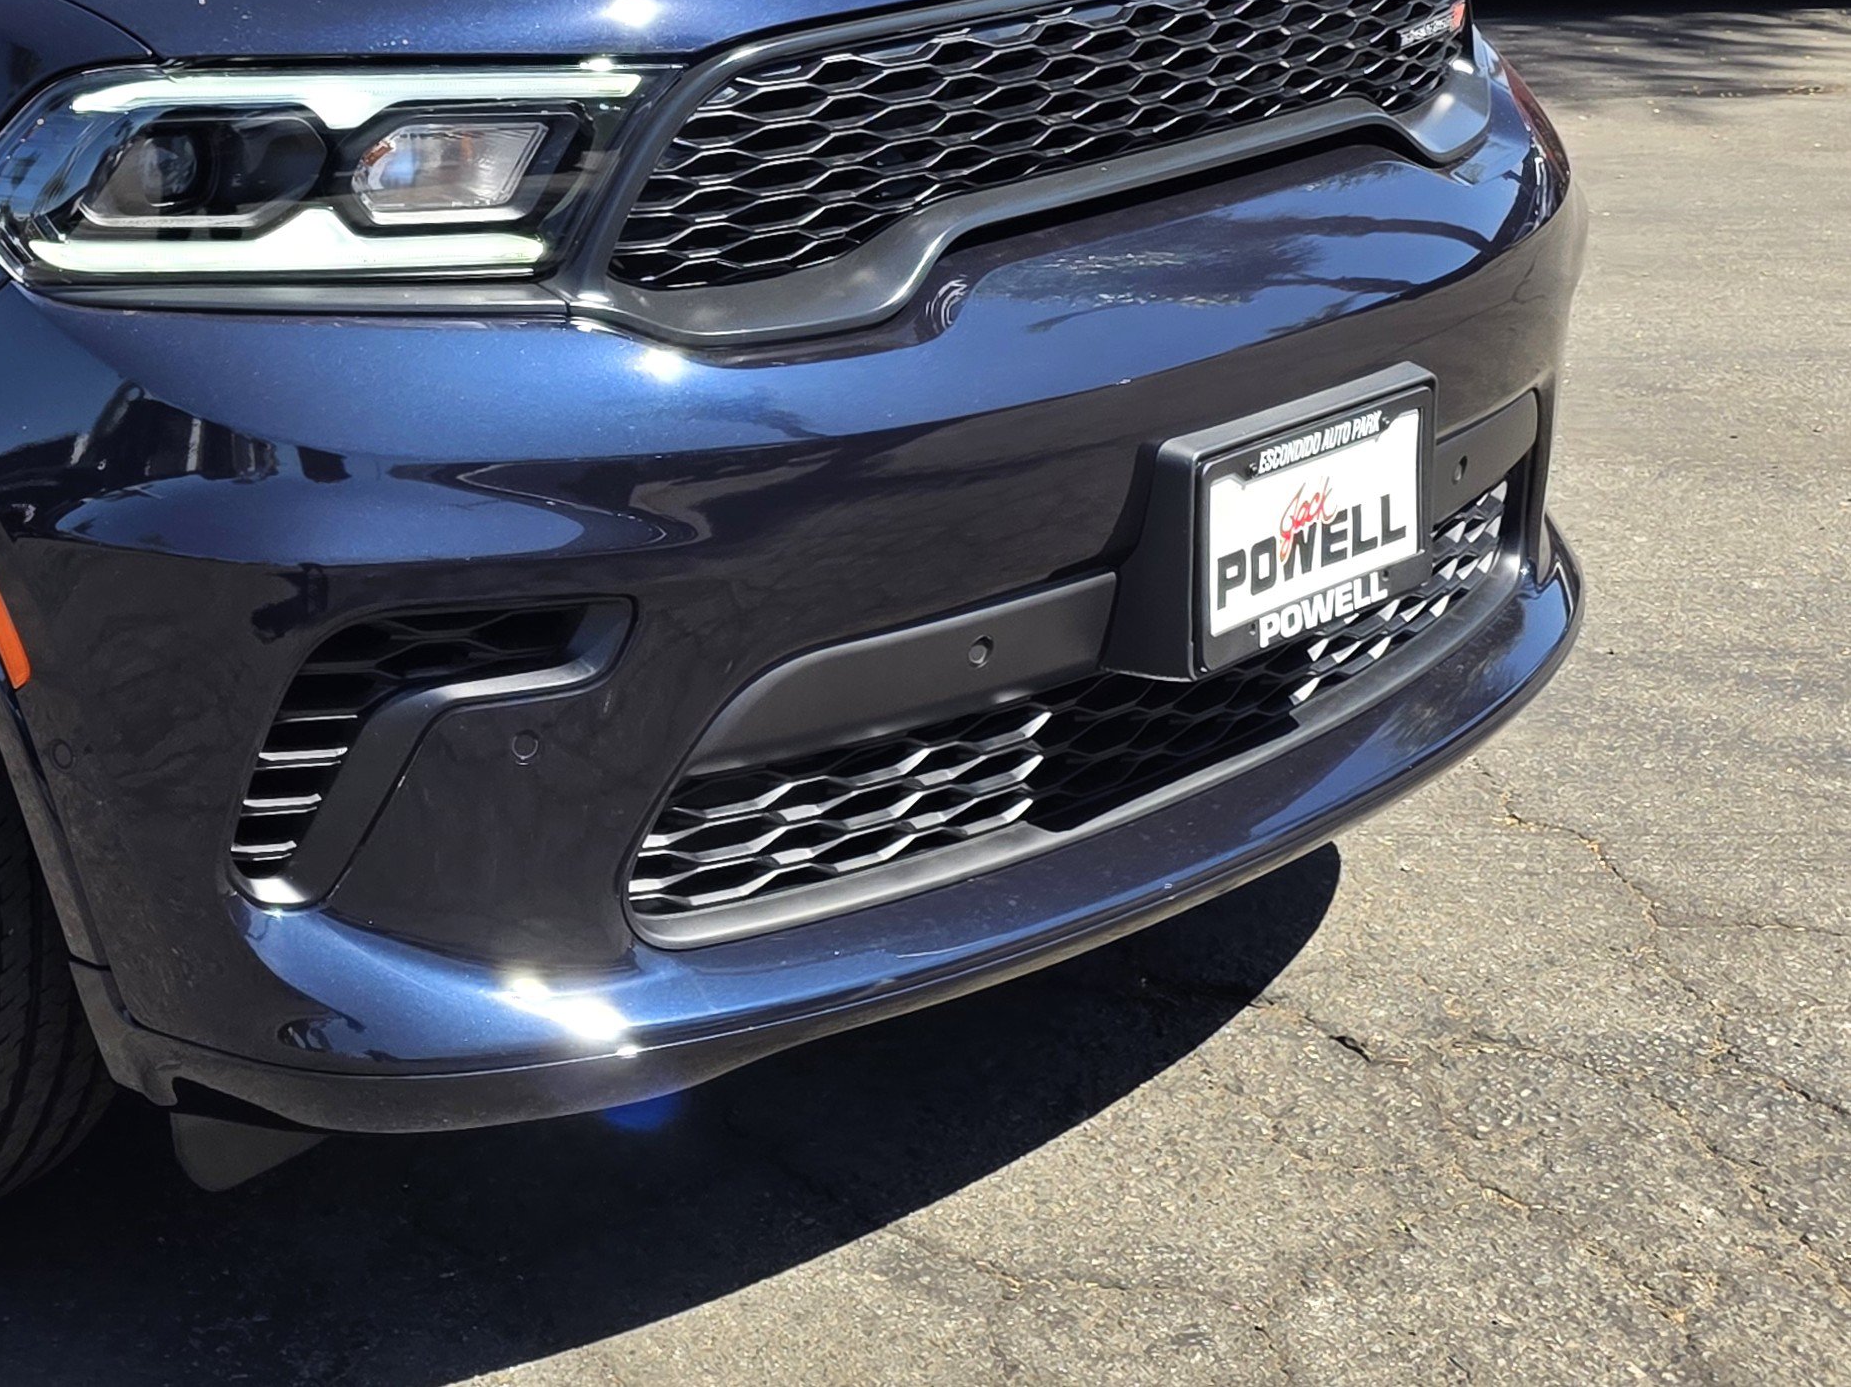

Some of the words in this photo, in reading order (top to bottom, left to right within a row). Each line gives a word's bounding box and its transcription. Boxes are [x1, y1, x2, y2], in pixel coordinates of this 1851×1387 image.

[1258, 432, 1322, 474] ESCONDIDO
[1321, 421, 1352, 452] AUTO
[1351, 410, 1382, 441] PARK
[1217, 494, 1407, 611] POWELL
[1279, 476, 1337, 563] Jack
[1259, 571, 1388, 648] POWELL
